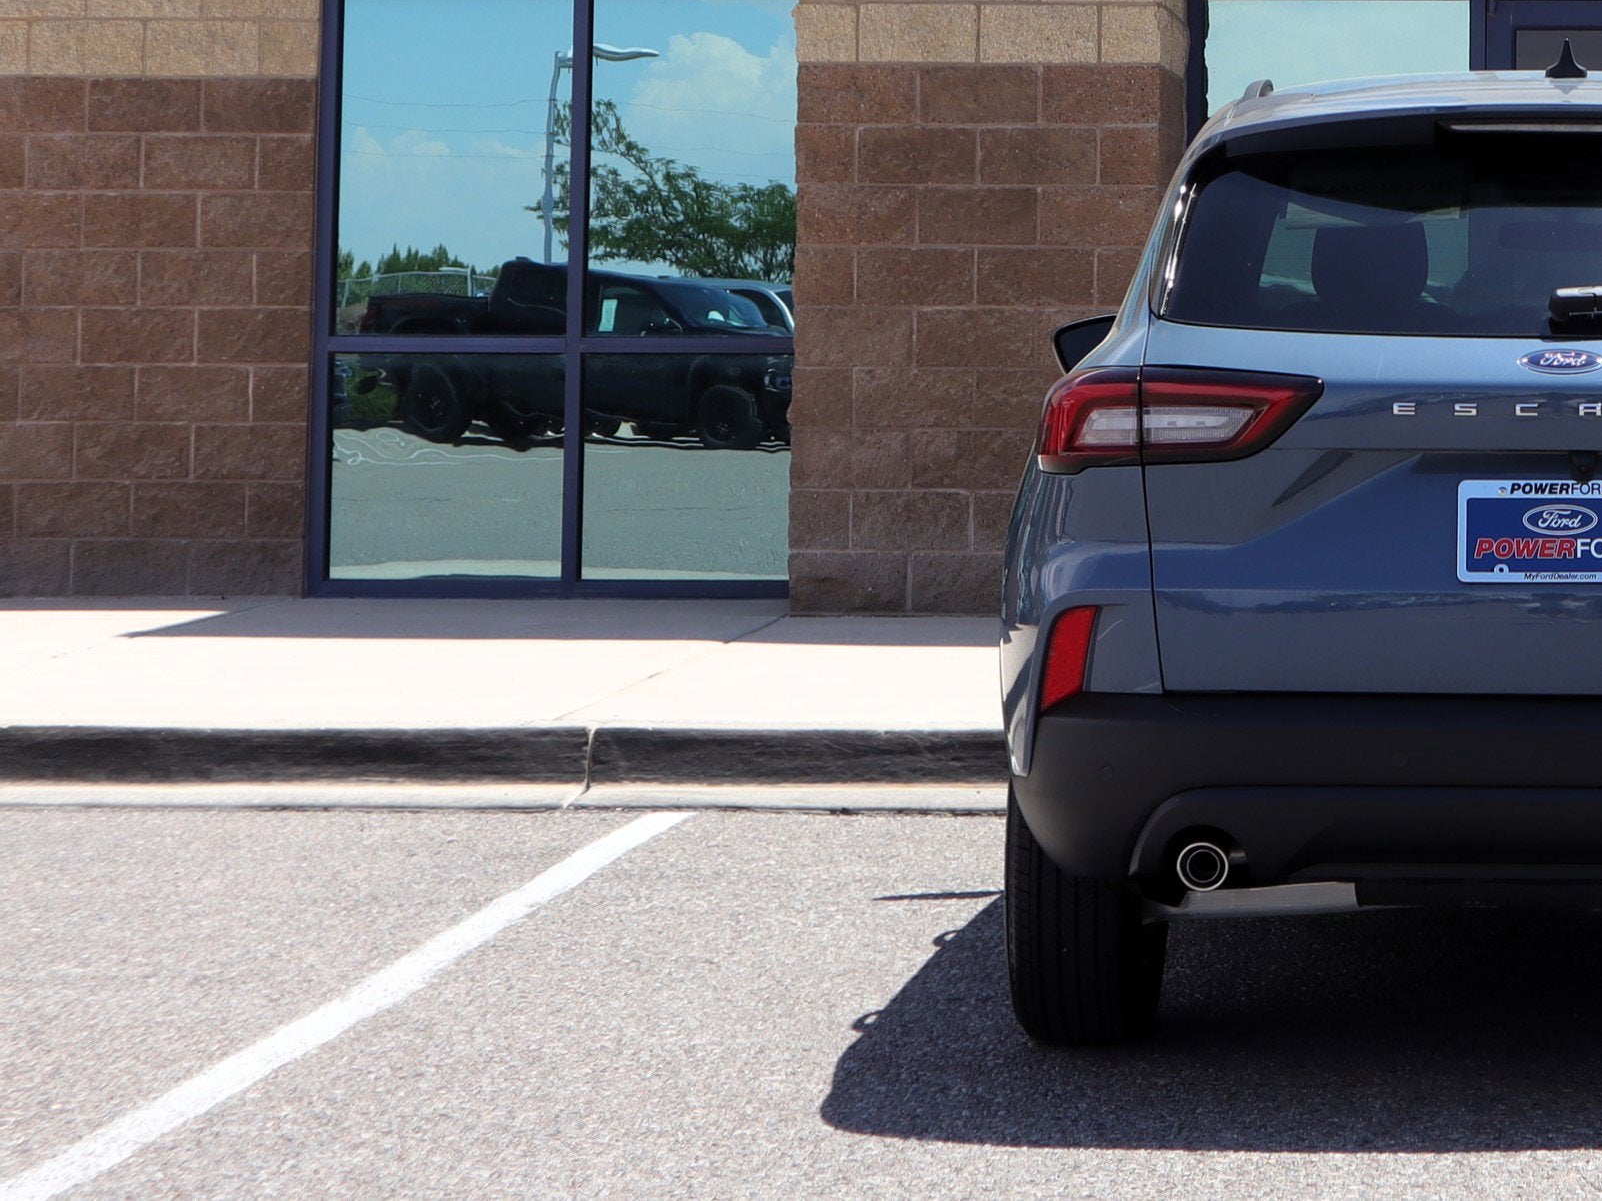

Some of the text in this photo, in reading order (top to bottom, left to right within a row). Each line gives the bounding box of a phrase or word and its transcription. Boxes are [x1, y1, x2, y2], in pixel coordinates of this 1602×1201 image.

[1540, 352, 1587, 367] Ford
[1538, 509, 1582, 529] Ford
[1523, 572, 1598, 581] MyFordDealer.com
